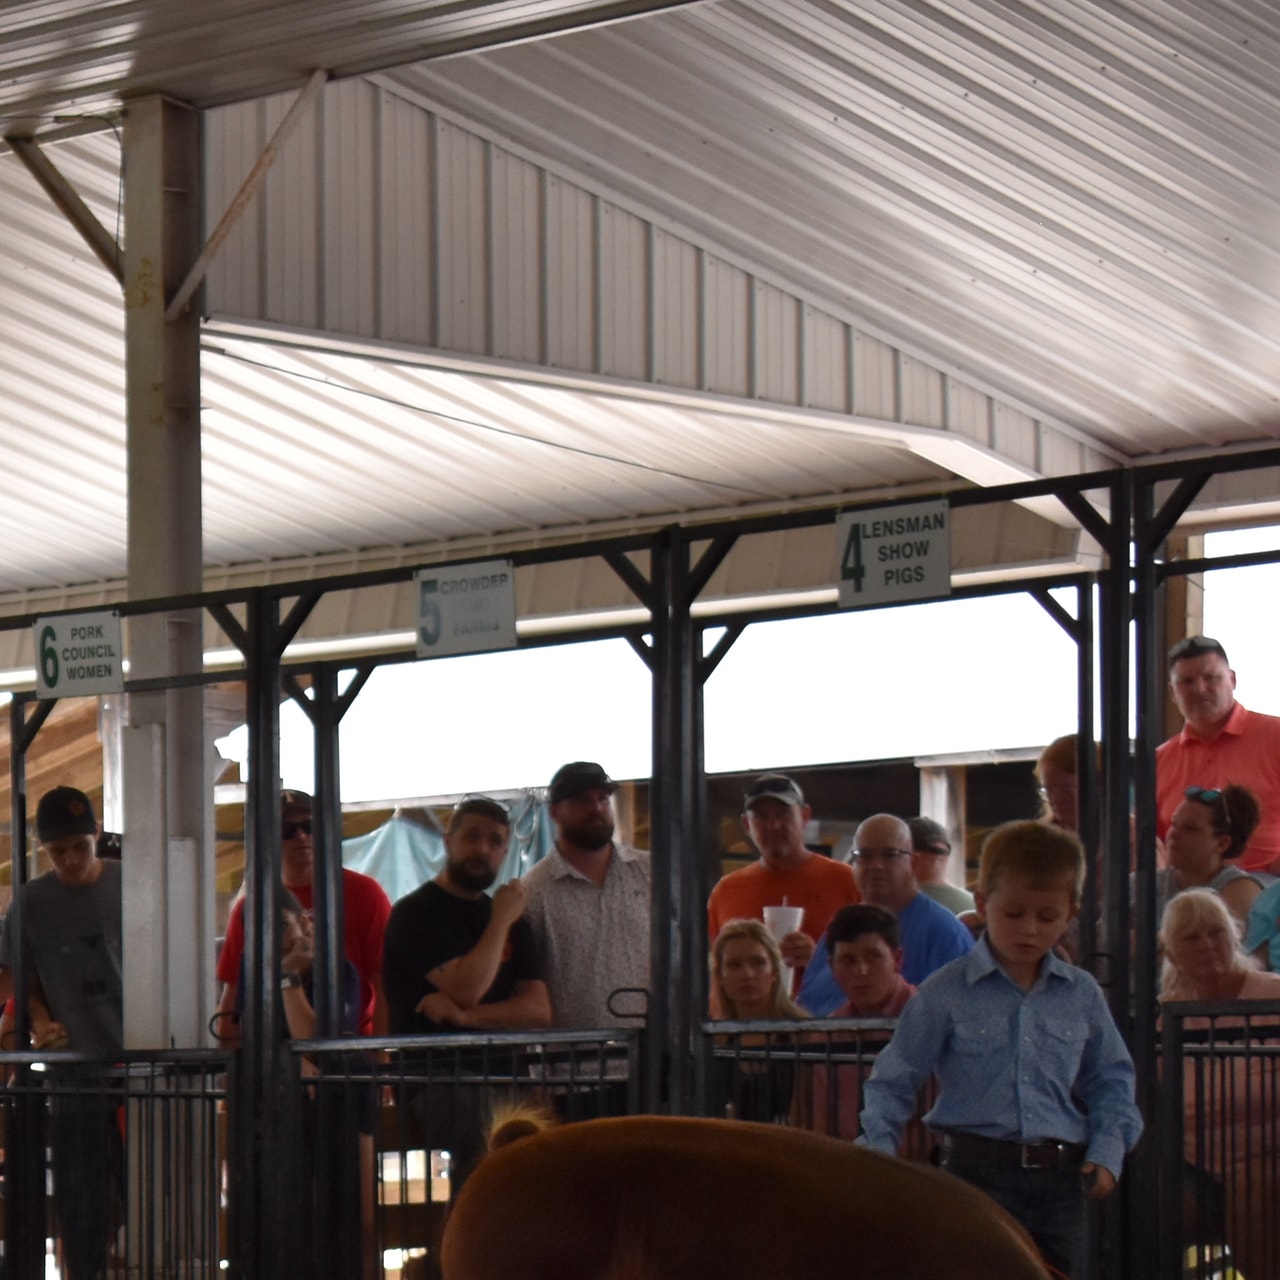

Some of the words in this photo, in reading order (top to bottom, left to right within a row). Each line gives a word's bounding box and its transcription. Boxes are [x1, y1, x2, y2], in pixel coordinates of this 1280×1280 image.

[862, 513, 944, 539] LENSMAN
[841, 522, 865, 593] 4
[878, 540, 929, 561] SHOW
[440, 573, 508, 595] CROWDER
[885, 566, 925, 586] PIGS
[421, 579, 441, 646] 5
[70, 625, 104, 640] PORK
[41, 625, 59, 689] 6
[62, 644, 116, 661] COUNCIL
[66, 664, 112, 680] WOMEN
